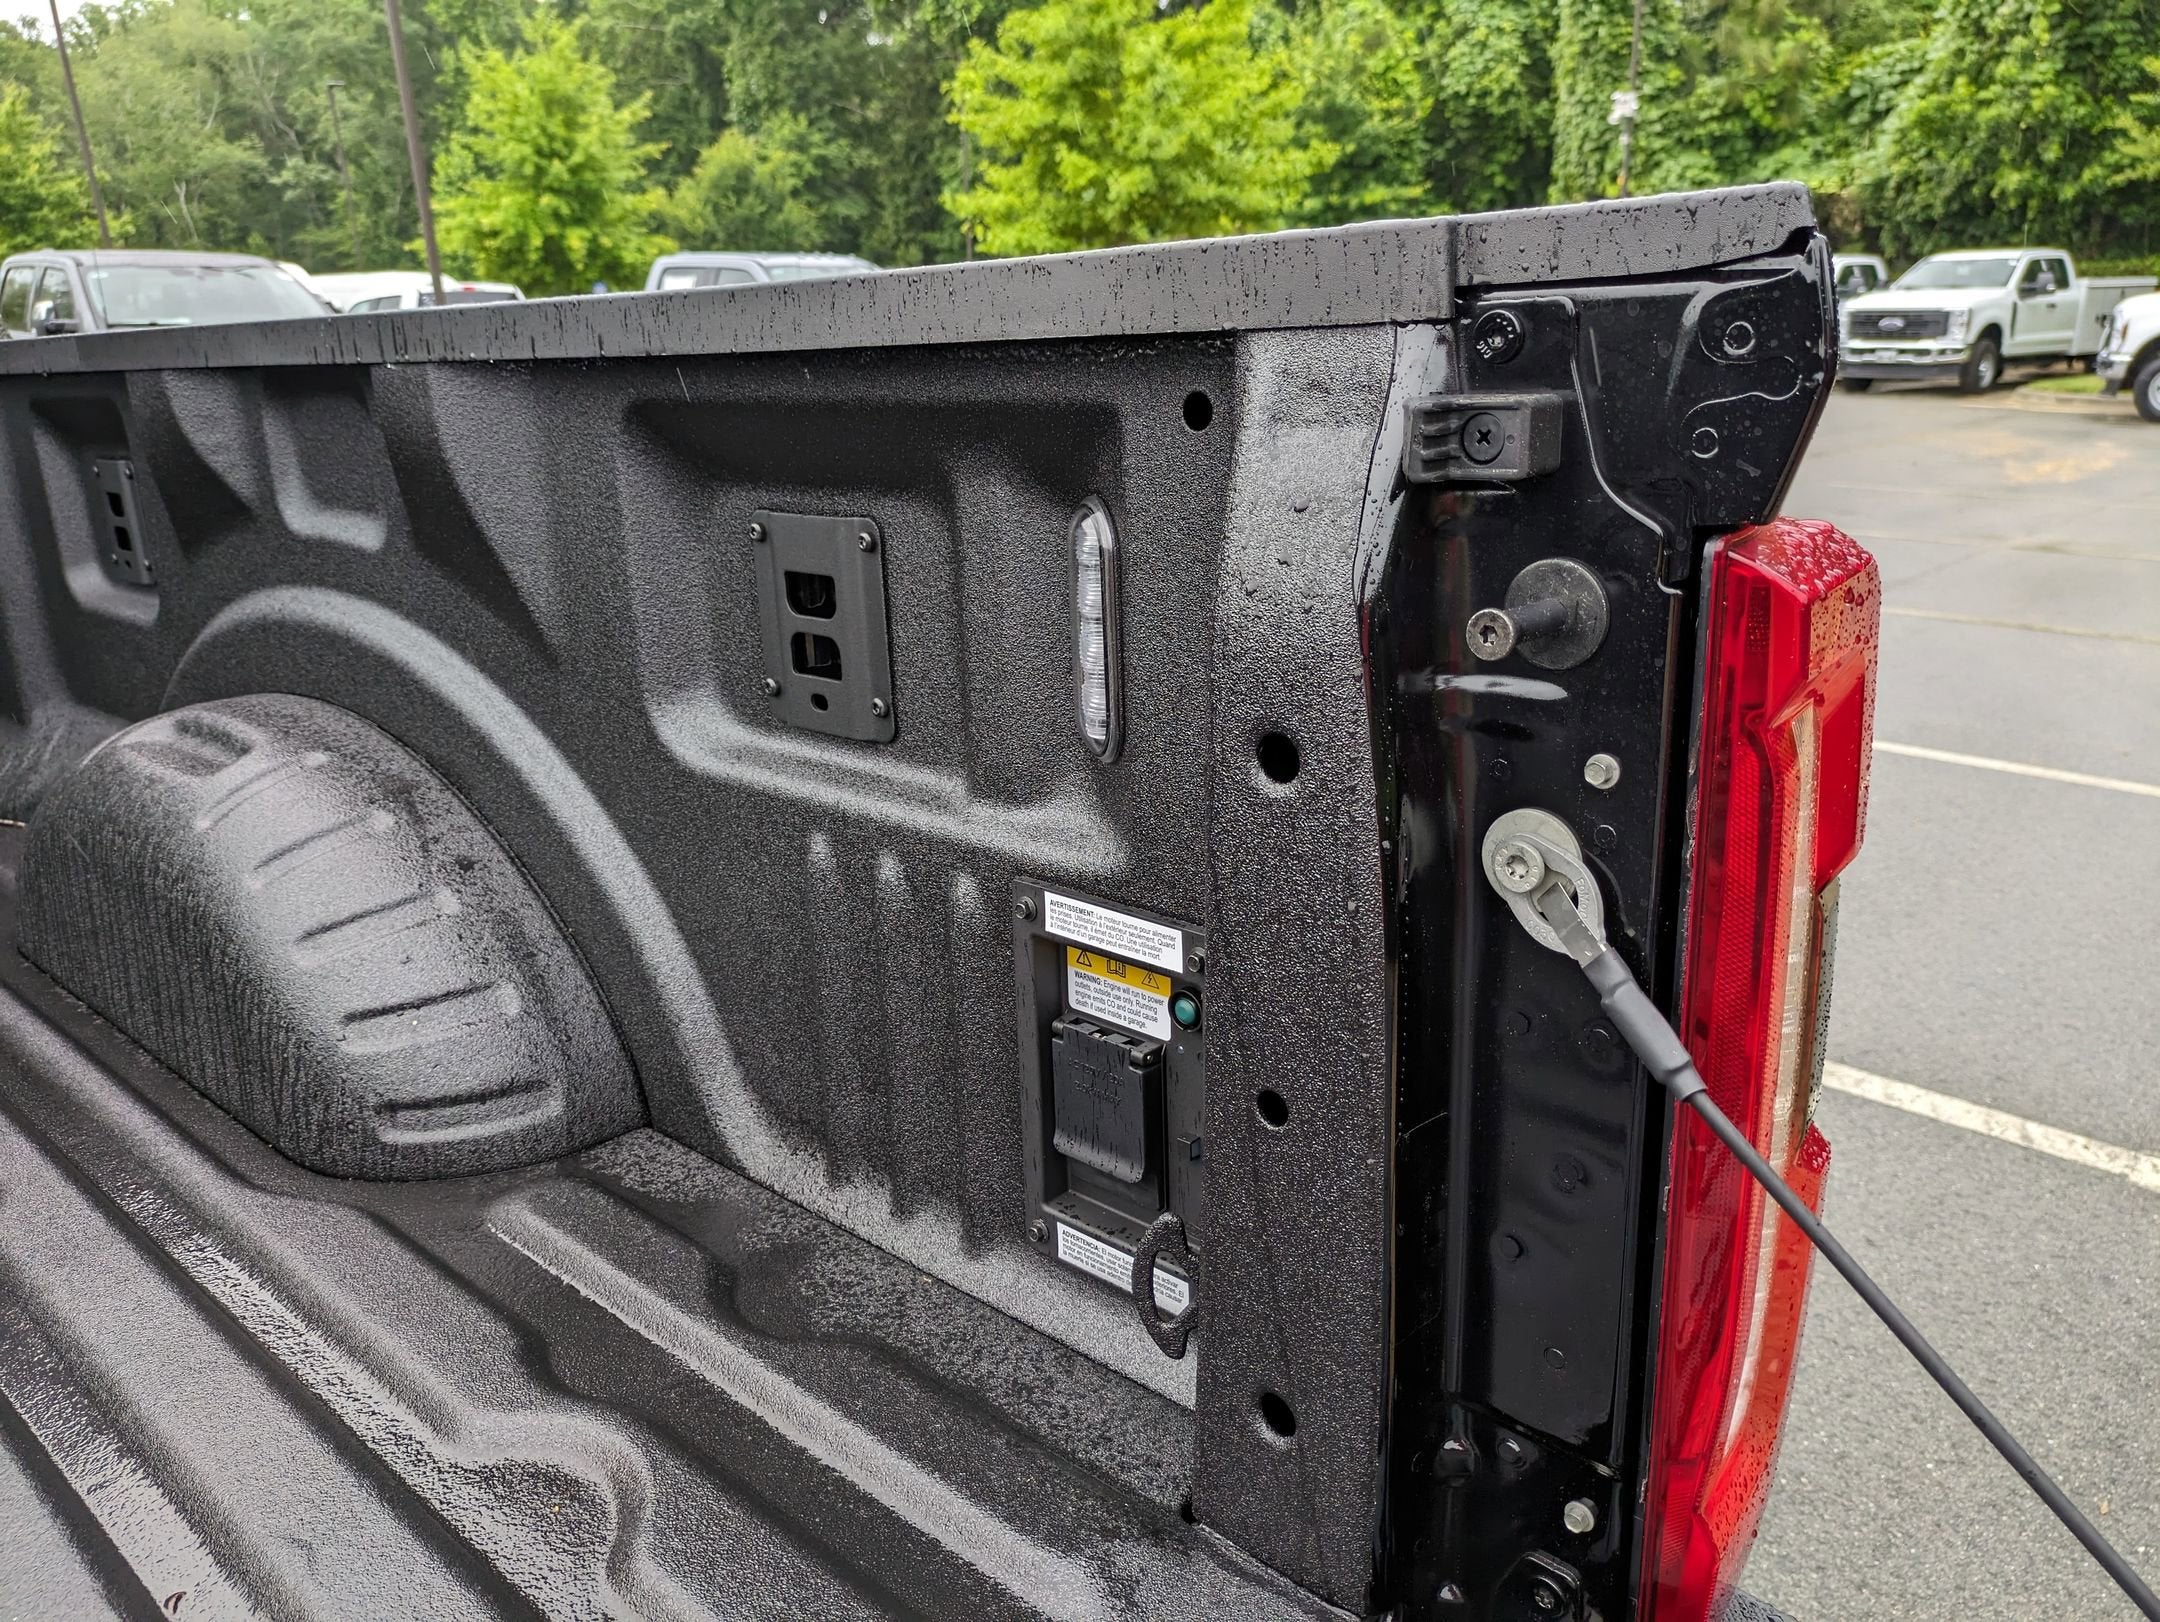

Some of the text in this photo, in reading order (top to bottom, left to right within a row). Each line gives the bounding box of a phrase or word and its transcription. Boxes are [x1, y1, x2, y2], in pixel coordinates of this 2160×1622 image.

[1049, 898, 1095, 919] AVERTISSEMENT:
[1074, 969, 1103, 987] WARNING:
[1103, 979, 1121, 994] Engine
[1121, 986, 1130, 996] will
[1130, 990, 1141, 999] run
[1147, 995, 1164, 1008] power
[1092, 985, 1111, 998] outside
[1112, 993, 1122, 1002] use
[1135, 998, 1158, 1016] Running
[1075, 989, 1158, 1024] engine emits CO and could cause
[1075, 997, 1089, 1008] death
[1093, 1003, 1107, 1015] used
[1107, 1007, 1122, 1020] inside
[1062, 1228, 1101, 1253] ADVERTENCIA:
